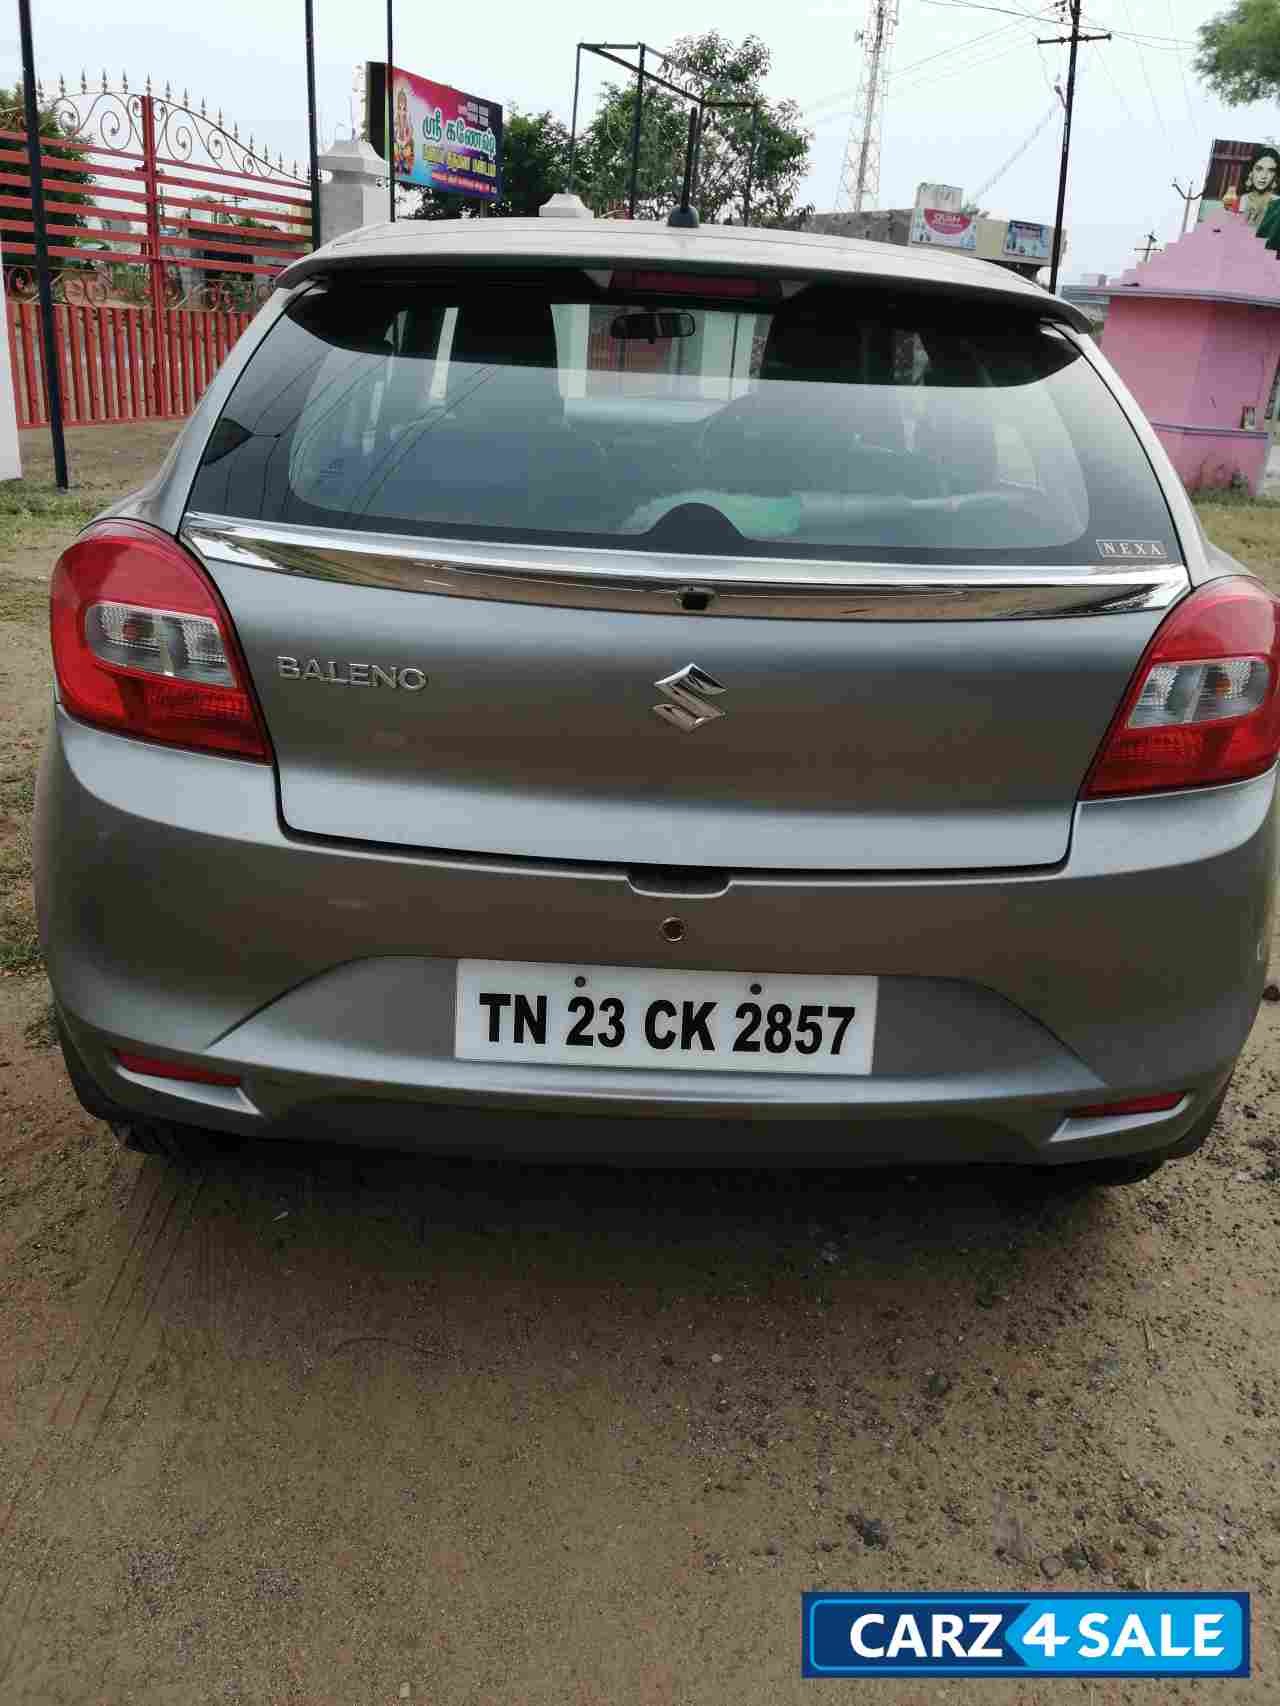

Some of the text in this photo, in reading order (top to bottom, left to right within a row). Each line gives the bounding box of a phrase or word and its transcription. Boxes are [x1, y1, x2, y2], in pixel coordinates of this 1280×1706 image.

[1103, 542, 1168, 555] NEXA
[276, 655, 427, 690] BALENO
[479, 992, 856, 1055] TN 23 CK 2857
